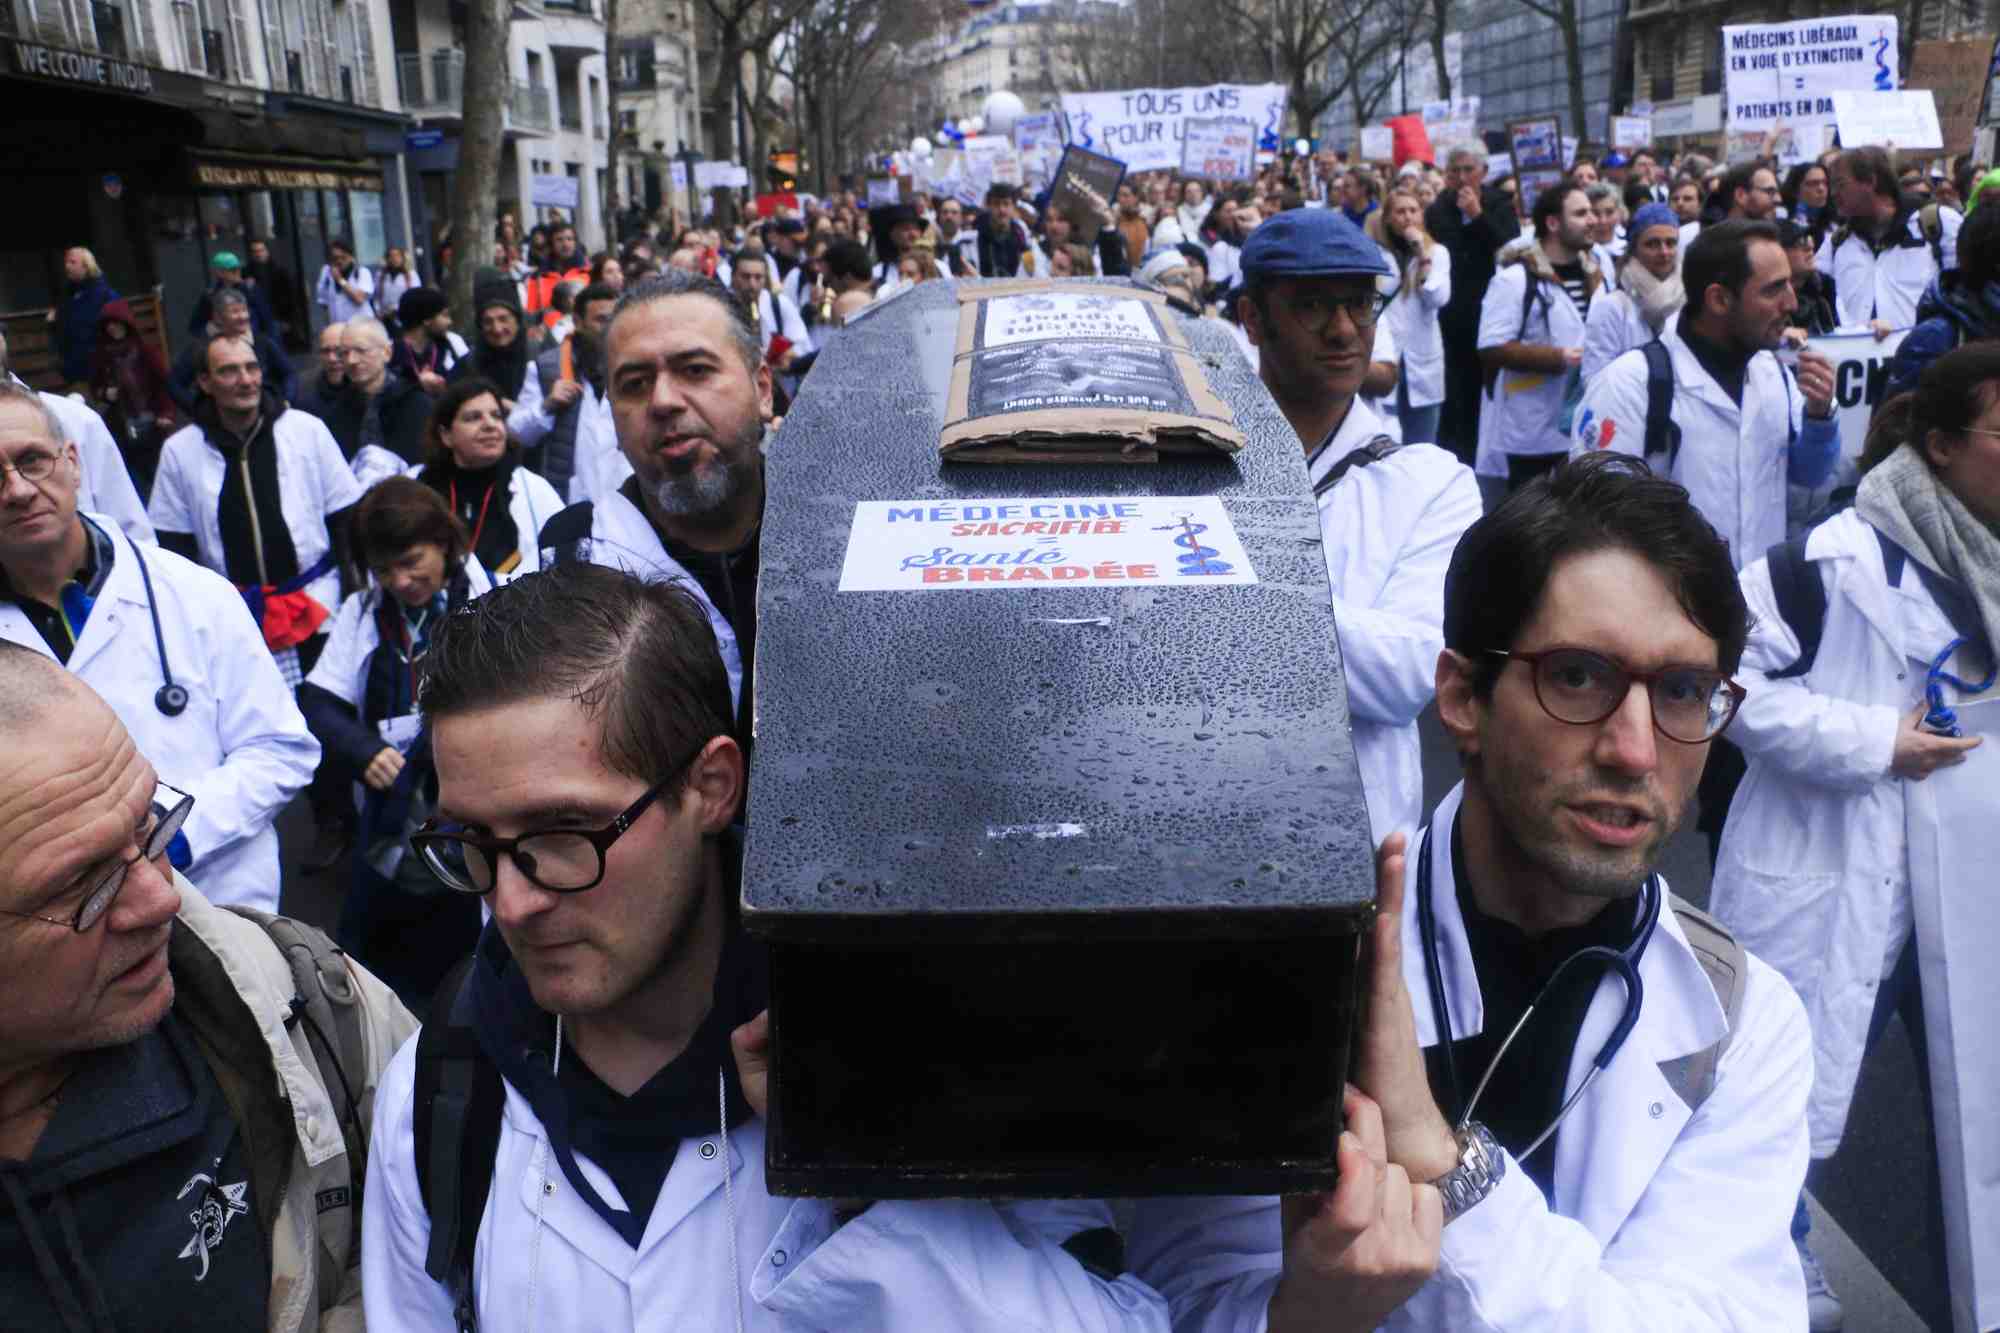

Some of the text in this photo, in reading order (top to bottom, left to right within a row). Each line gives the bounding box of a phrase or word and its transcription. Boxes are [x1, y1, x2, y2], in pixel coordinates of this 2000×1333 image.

[1732, 24, 1858, 49] MÉDECINS LIBÉRAUX
[16, 42, 153, 92] WELCOME INDIA
[1731, 47, 1864, 70] EN VOIE D'EXTINCTION
[1121, 91, 1183, 117] TOUS
[1736, 101, 1792, 119] PATIENTS
[1796, 98, 1812, 116] EN
[1103, 120, 1163, 146] POUR
[887, 502, 1143, 522] MÉDECINE
[900, 547, 1067, 571] Santé
[922, 561, 1160, 583] BRADÉE
